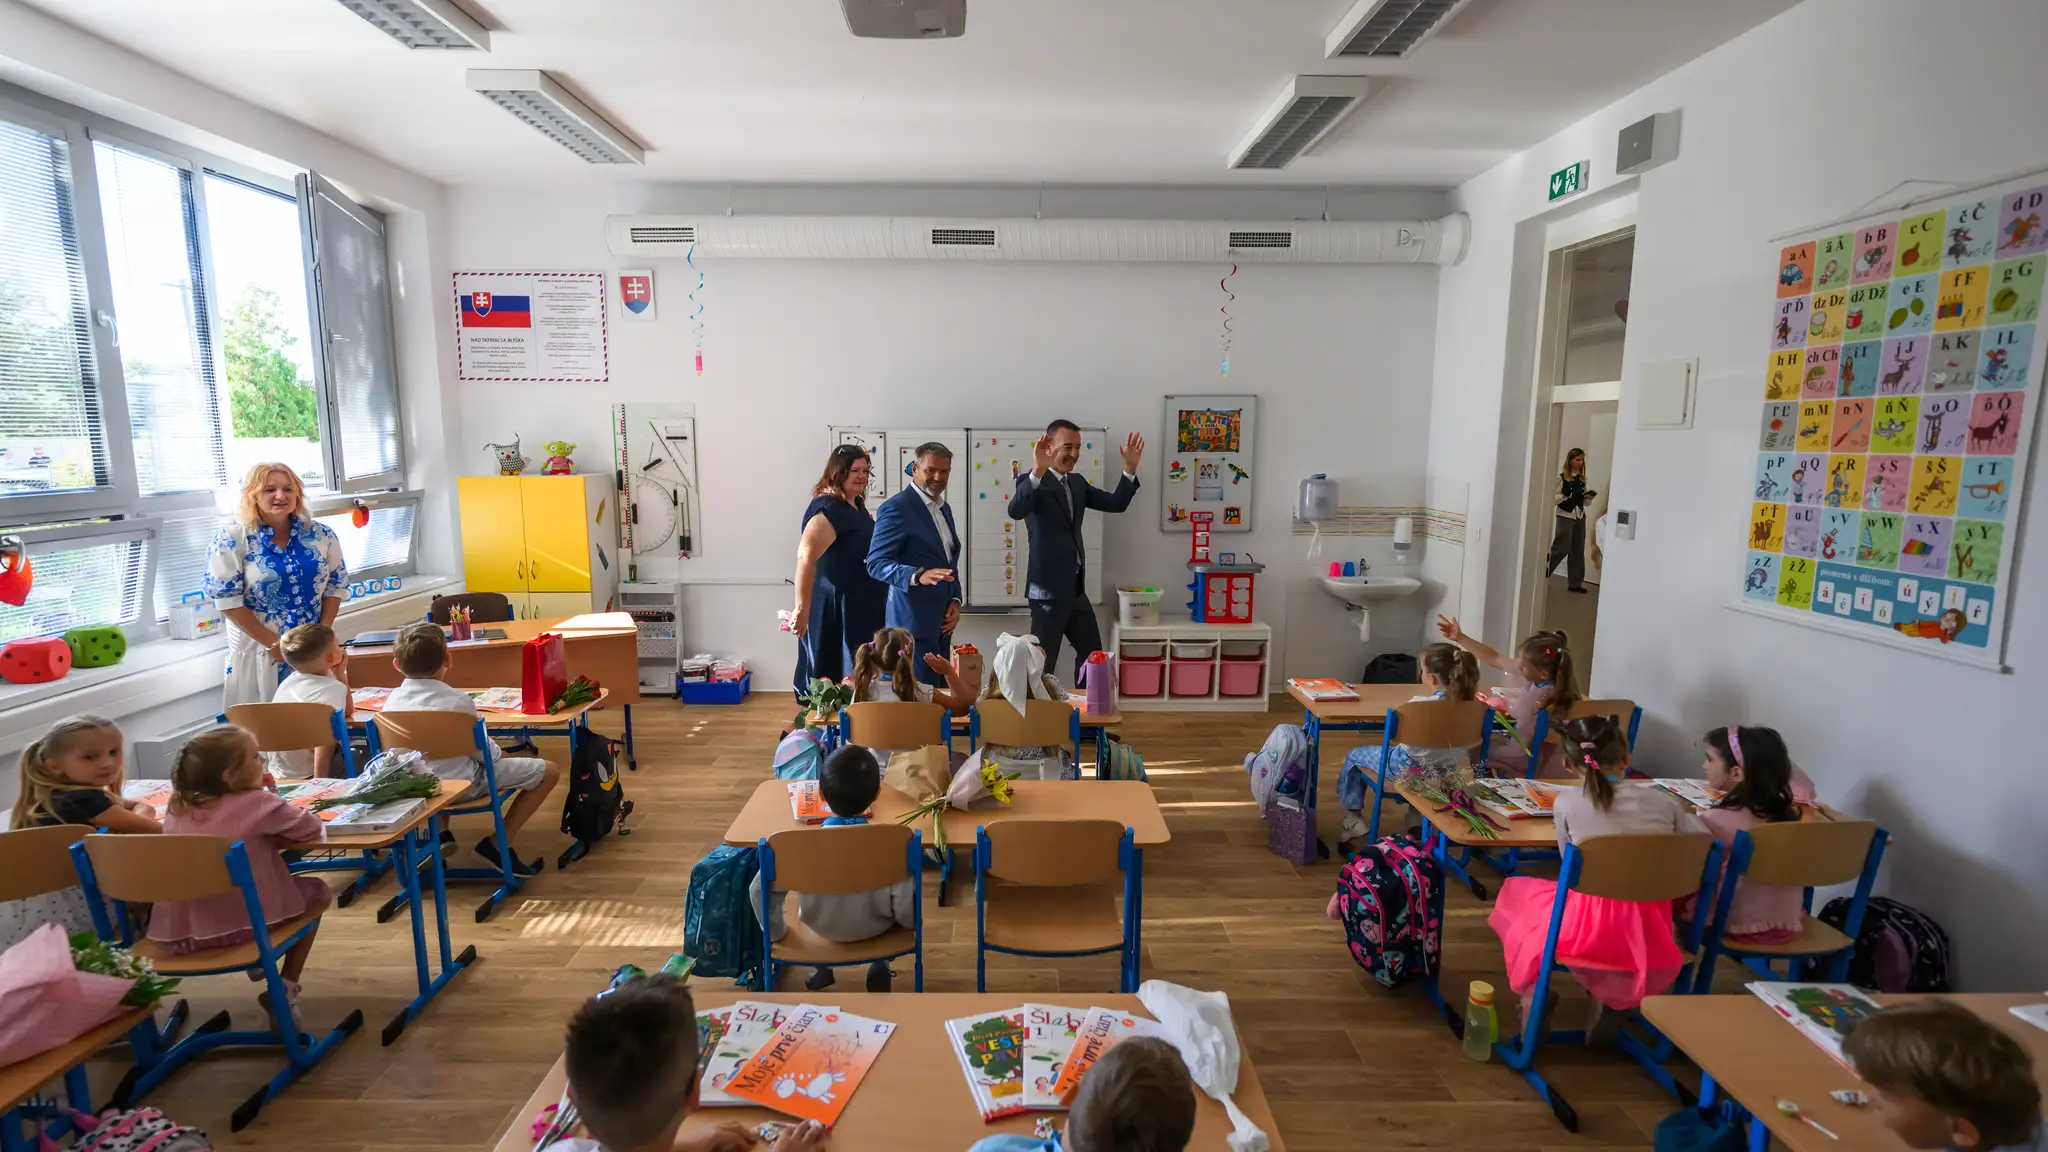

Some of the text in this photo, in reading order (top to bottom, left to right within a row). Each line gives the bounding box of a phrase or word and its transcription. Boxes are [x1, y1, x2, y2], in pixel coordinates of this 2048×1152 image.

[2013, 193, 2042, 211] d D
[1959, 202, 1985, 223] č Č
[1910, 218, 1934, 234] c C
[1865, 228, 1886, 244] b B
[1798, 248, 1806, 258] A
[2002, 262, 2033, 282] g G
[1954, 271, 1976, 288] f F
[1902, 280, 1925, 294] e E
[1851, 286, 1886, 303] dž Dž
[1814, 295, 1844, 309] dz Dz
[1942, 335, 1970, 350] k K
[2007, 331, 2019, 344] L
[1808, 350, 1837, 363] ch Ch
[1854, 346, 1867, 358] i I
[1894, 341, 1914, 358] j J
[1777, 354, 1797, 366] h H
[1804, 405, 1828, 416] m M
[1843, 403, 1863, 414] n N
[1886, 397, 1909, 414] ň Ň
[1932, 400, 1959, 412] o O
[1767, 457, 1785, 470] p P
[1800, 458, 1820, 471] q Q
[1836, 459, 1856, 470] r R
[1879, 460, 1898, 472] s S
[1926, 458, 1947, 474] š Š
[1978, 462, 2001, 475] t T
[1795, 510, 1813, 521] u U
[1842, 514, 1851, 524] V
[1867, 517, 1897, 529] w W
[1916, 521, 1940, 535] x X
[1965, 526, 1993, 541] y Y
[1763, 557, 1771, 567] Z
[1789, 558, 1806, 573] ž Ž
[1823, 587, 1828, 598] á
[1904, 584, 1911, 597] ú
[1924, 597, 1934, 613] ý
[1030, 1008, 1084, 1028] Šlab
[1088, 1012, 1118, 1037] čiary
[736, 1024, 742, 1032] 1
[734, 1008, 823, 1093] Moje prvé čiary
[981, 1048, 1024, 1065] PRV
